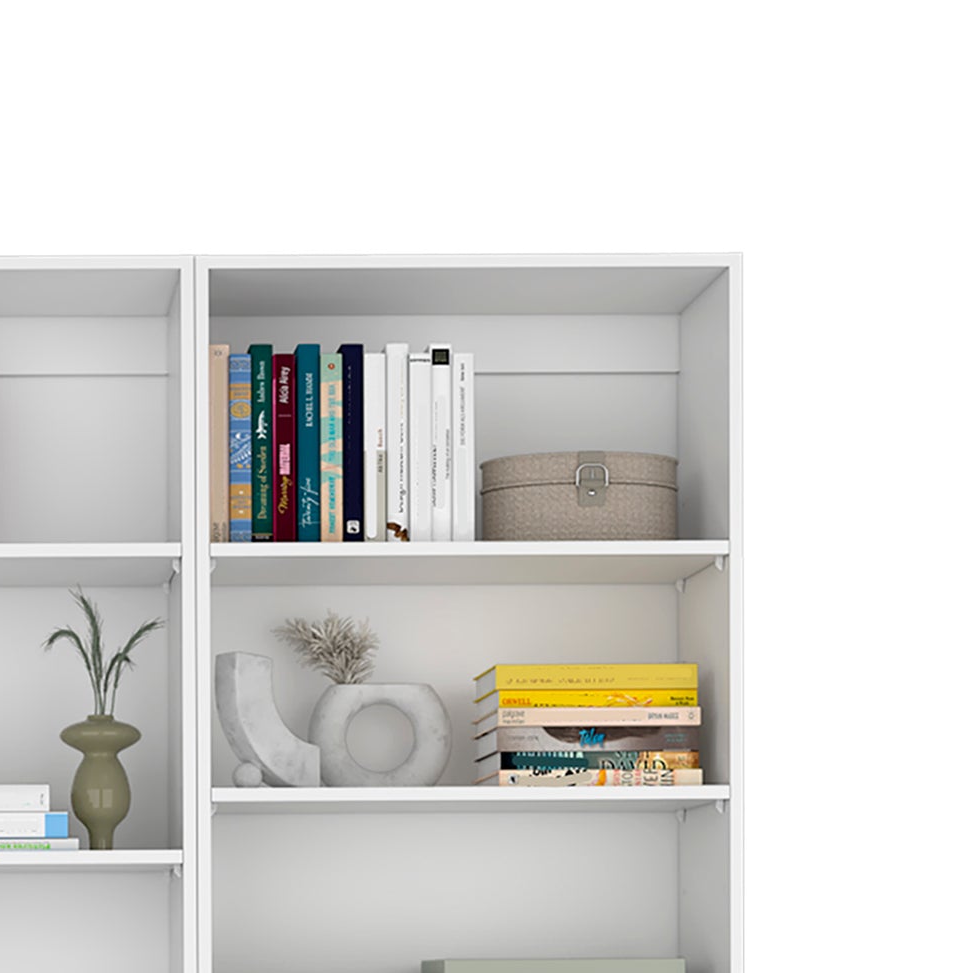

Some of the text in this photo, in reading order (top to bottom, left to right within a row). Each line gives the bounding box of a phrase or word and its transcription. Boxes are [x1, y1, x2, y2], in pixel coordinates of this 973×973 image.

[256, 446, 268, 519] Dreaming of Sweden
